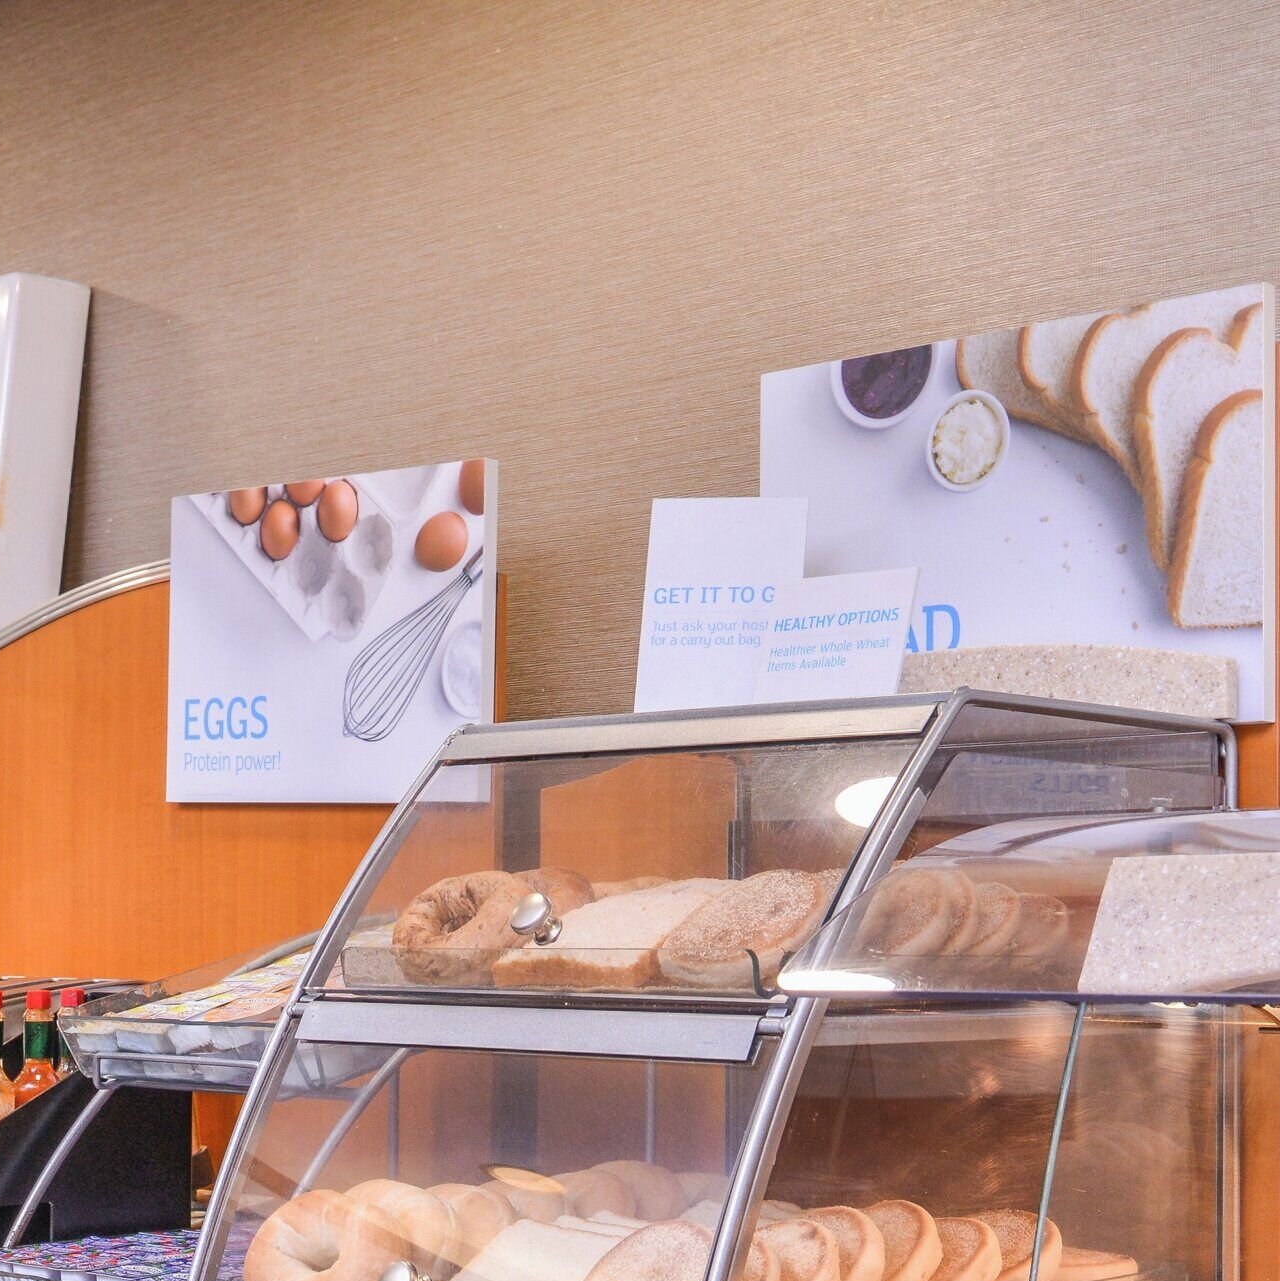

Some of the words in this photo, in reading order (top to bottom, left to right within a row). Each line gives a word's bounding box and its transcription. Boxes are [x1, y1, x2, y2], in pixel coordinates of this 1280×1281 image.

[654, 587, 694, 605] GET
[699, 586, 722, 604] IT
[728, 586, 755, 603] TO
[652, 621, 677, 632] Just
[682, 620, 703, 632] ask
[707, 621, 737, 633] your
[774, 614, 836, 632] HEALTHY
[838, 607, 900, 626] OPTIONS
[650, 635, 666, 646] for
[670, 637, 677, 646] a
[680, 636, 712, 648] carry
[715, 635, 735, 645] out
[738, 634, 761, 648] bag
[770, 643, 817, 658] Healthier
[820, 640, 852, 653] Whole
[856, 637, 890, 650] Wheat
[767, 660, 796, 673] Items
[799, 655, 847, 670] Available
[184, 695, 268, 740] EGGS
[184, 752, 231, 773] Protein
[235, 751, 281, 776] power!
